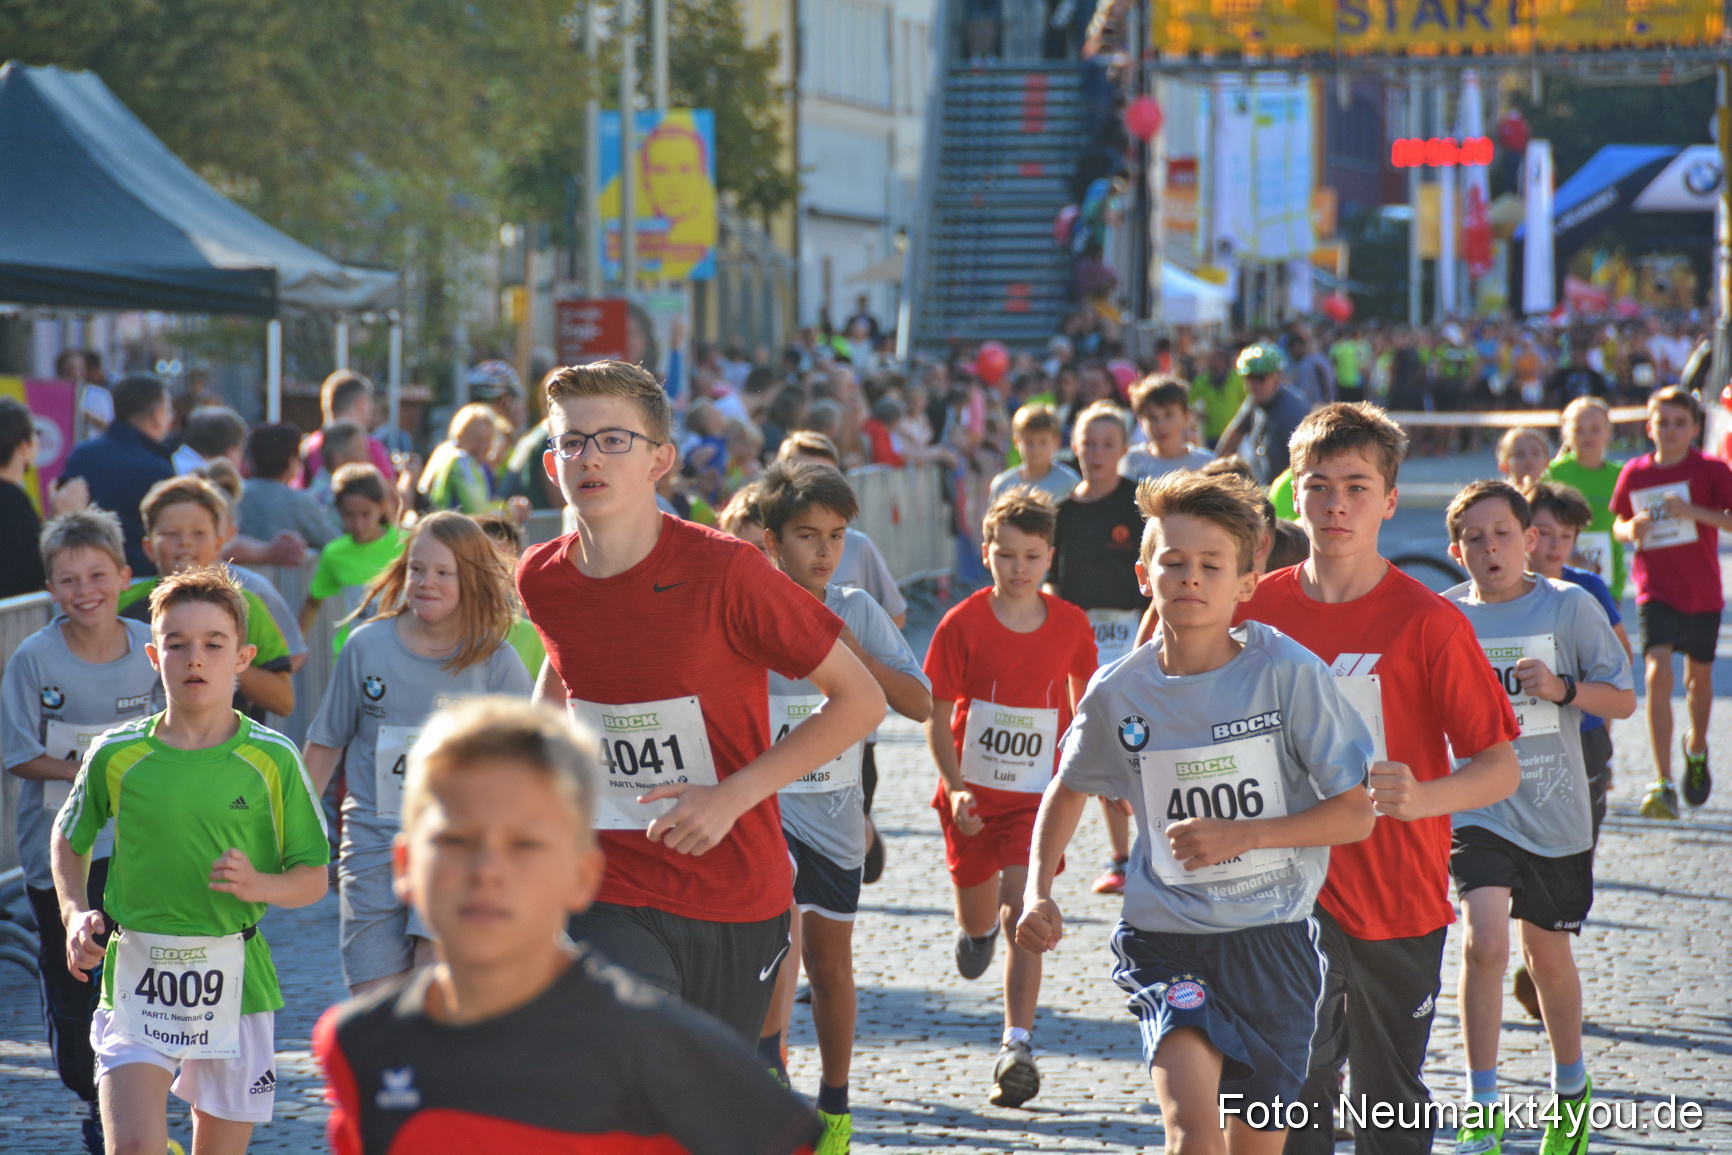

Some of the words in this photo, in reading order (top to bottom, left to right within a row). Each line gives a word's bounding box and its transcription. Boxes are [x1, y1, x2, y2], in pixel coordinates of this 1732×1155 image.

[1092, 623, 1128, 642] 049
[116, 694, 150, 711] BOC
[603, 713, 661, 729] BOCK
[995, 712, 1034, 726] BOCK
[1212, 710, 1281, 741] BOCK
[978, 726, 1042, 757] 4000
[598, 733, 685, 776] 4041
[1519, 754, 1555, 767] arkter
[1176, 755, 1237, 776] BOCK
[994, 768, 1016, 781] Luis
[609, 779, 635, 788] PARTL
[1166, 778, 1263, 821] 4006
[150, 946, 208, 960] BOCK
[134, 967, 224, 1008] 4009
[141, 1009, 170, 1021] PARTL
